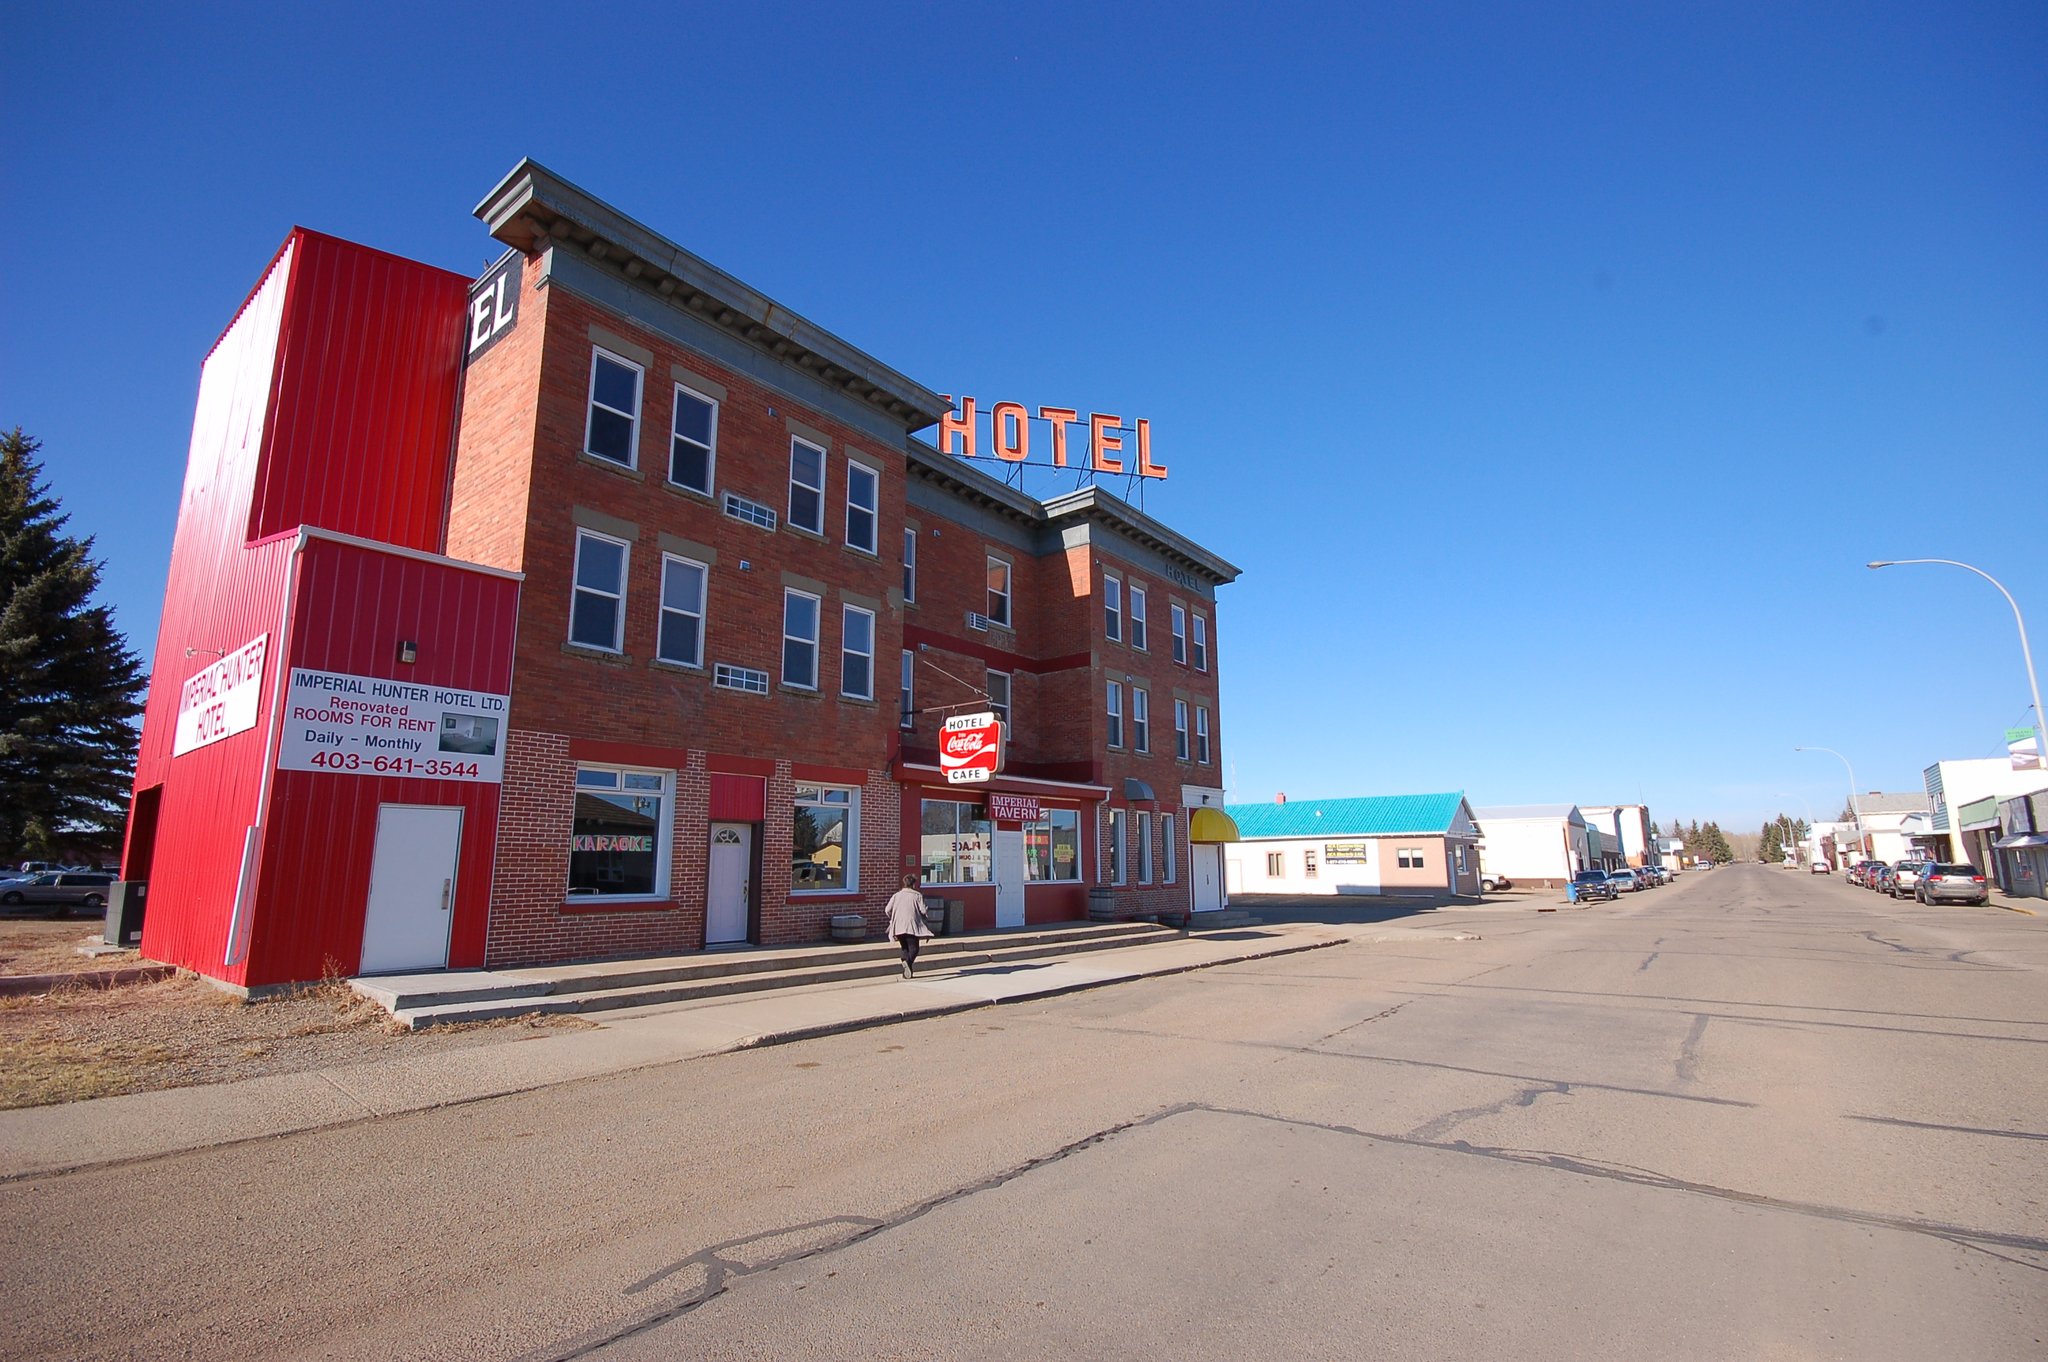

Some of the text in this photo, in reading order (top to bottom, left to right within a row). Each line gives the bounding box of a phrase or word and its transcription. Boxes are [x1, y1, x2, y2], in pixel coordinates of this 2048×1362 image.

[936, 393, 1168, 479] HOTEL
[1165, 564, 1201, 592] HOTEL
[220, 640, 263, 694] HUNTER
[295, 672, 506, 712] IMPERIAL HUNTER HOTEL LTD.
[329, 696, 409, 716] Renovated
[195, 701, 226, 743] HOTEL
[293, 707, 437, 733] ROOMS FOR RENT
[949, 718, 984, 730] HOTEL
[304, 729, 344, 747] Daily
[365, 734, 422, 753] Monthly
[310, 751, 479, 778] 403-641-3544
[952, 769, 981, 780] CAFE
[991, 795, 1039, 809] IMPERIAL
[992, 806, 1038, 820] TAVERN
[572, 834, 653, 852] KARAOKE
